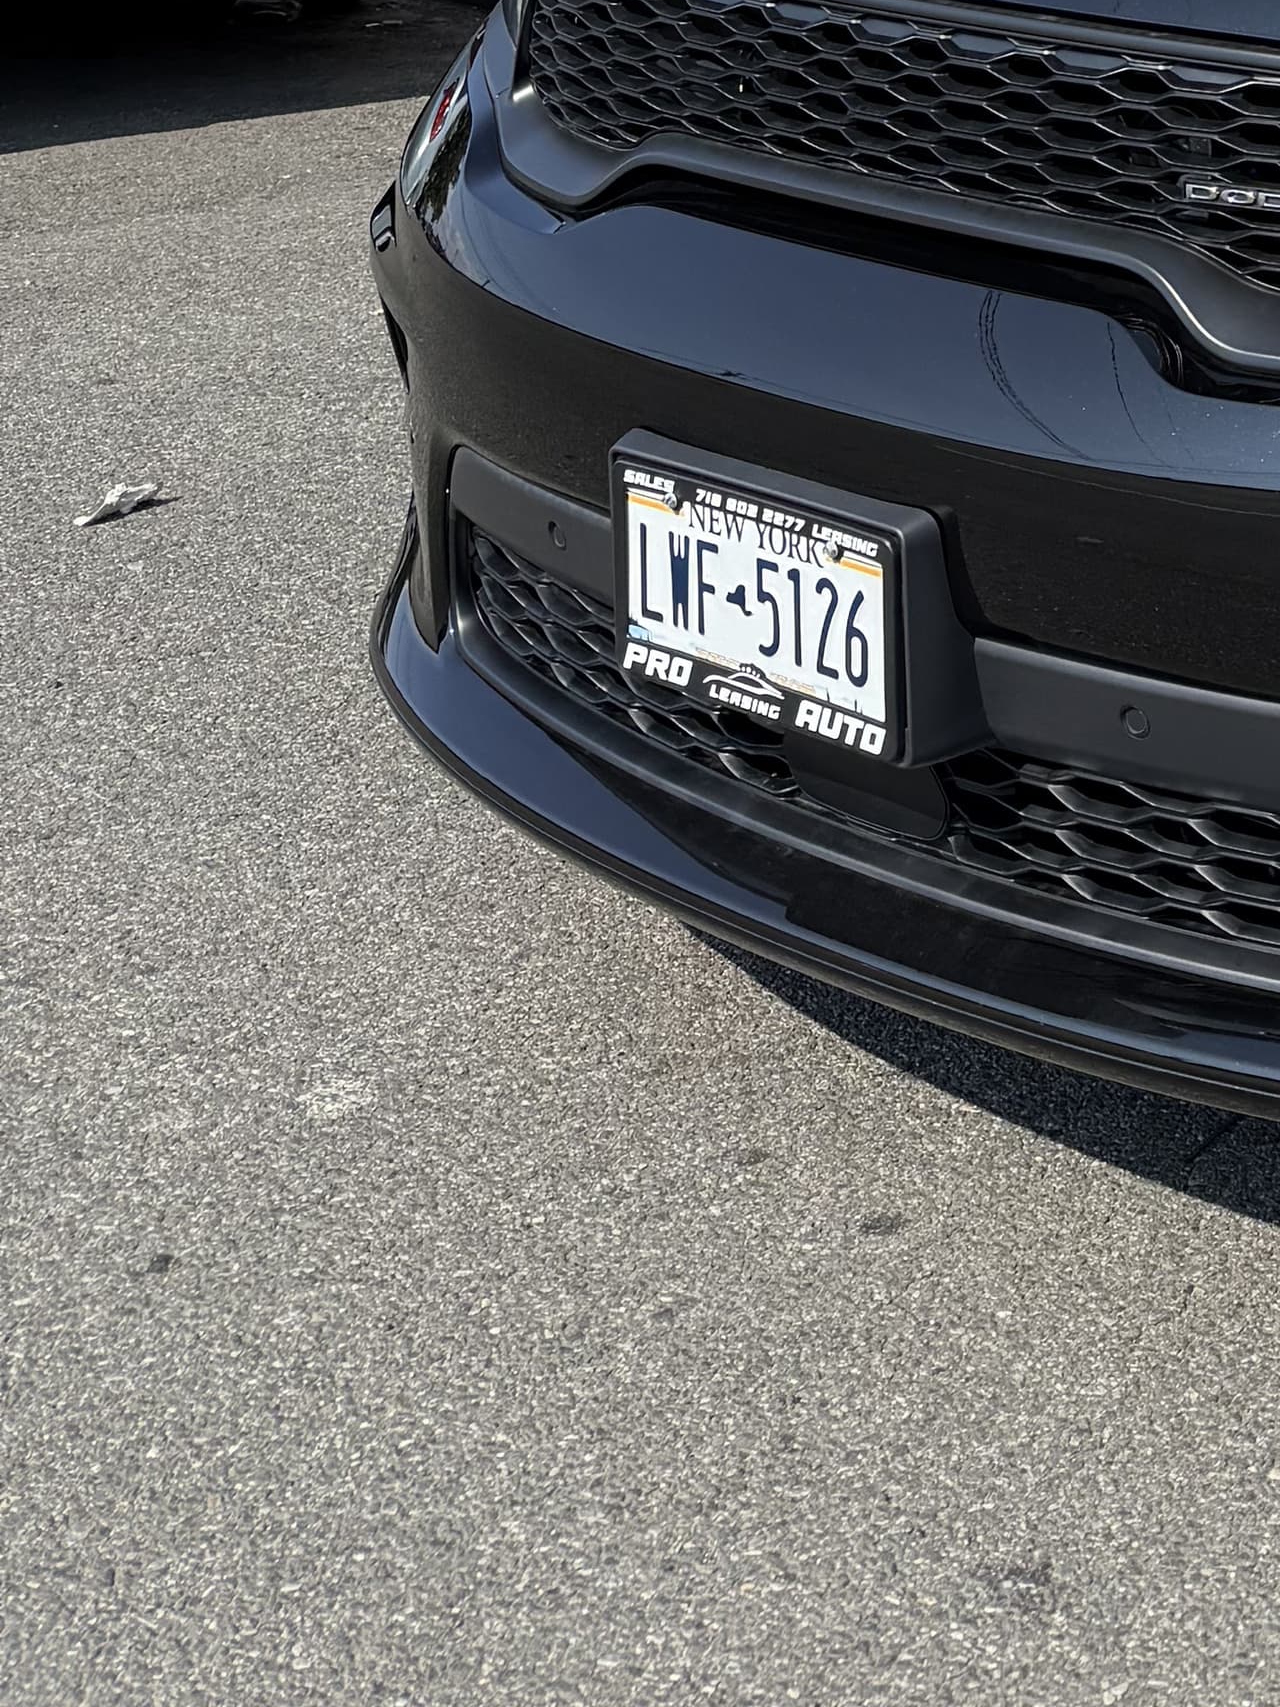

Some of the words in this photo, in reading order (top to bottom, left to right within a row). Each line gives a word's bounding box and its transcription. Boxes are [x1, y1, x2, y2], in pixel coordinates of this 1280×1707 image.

[623, 469, 675, 492] SALES
[696, 489, 722, 507] 718
[761, 508, 805, 532] 2277
[689, 503, 746, 543] NEW
[757, 522, 825, 569] YORK
[640, 523, 720, 635] LWF
[756, 558, 869, 688] 5126
[623, 643, 694, 686] PRO
[709, 684, 782, 720] LEASING
[794, 700, 887, 756] AUTO
